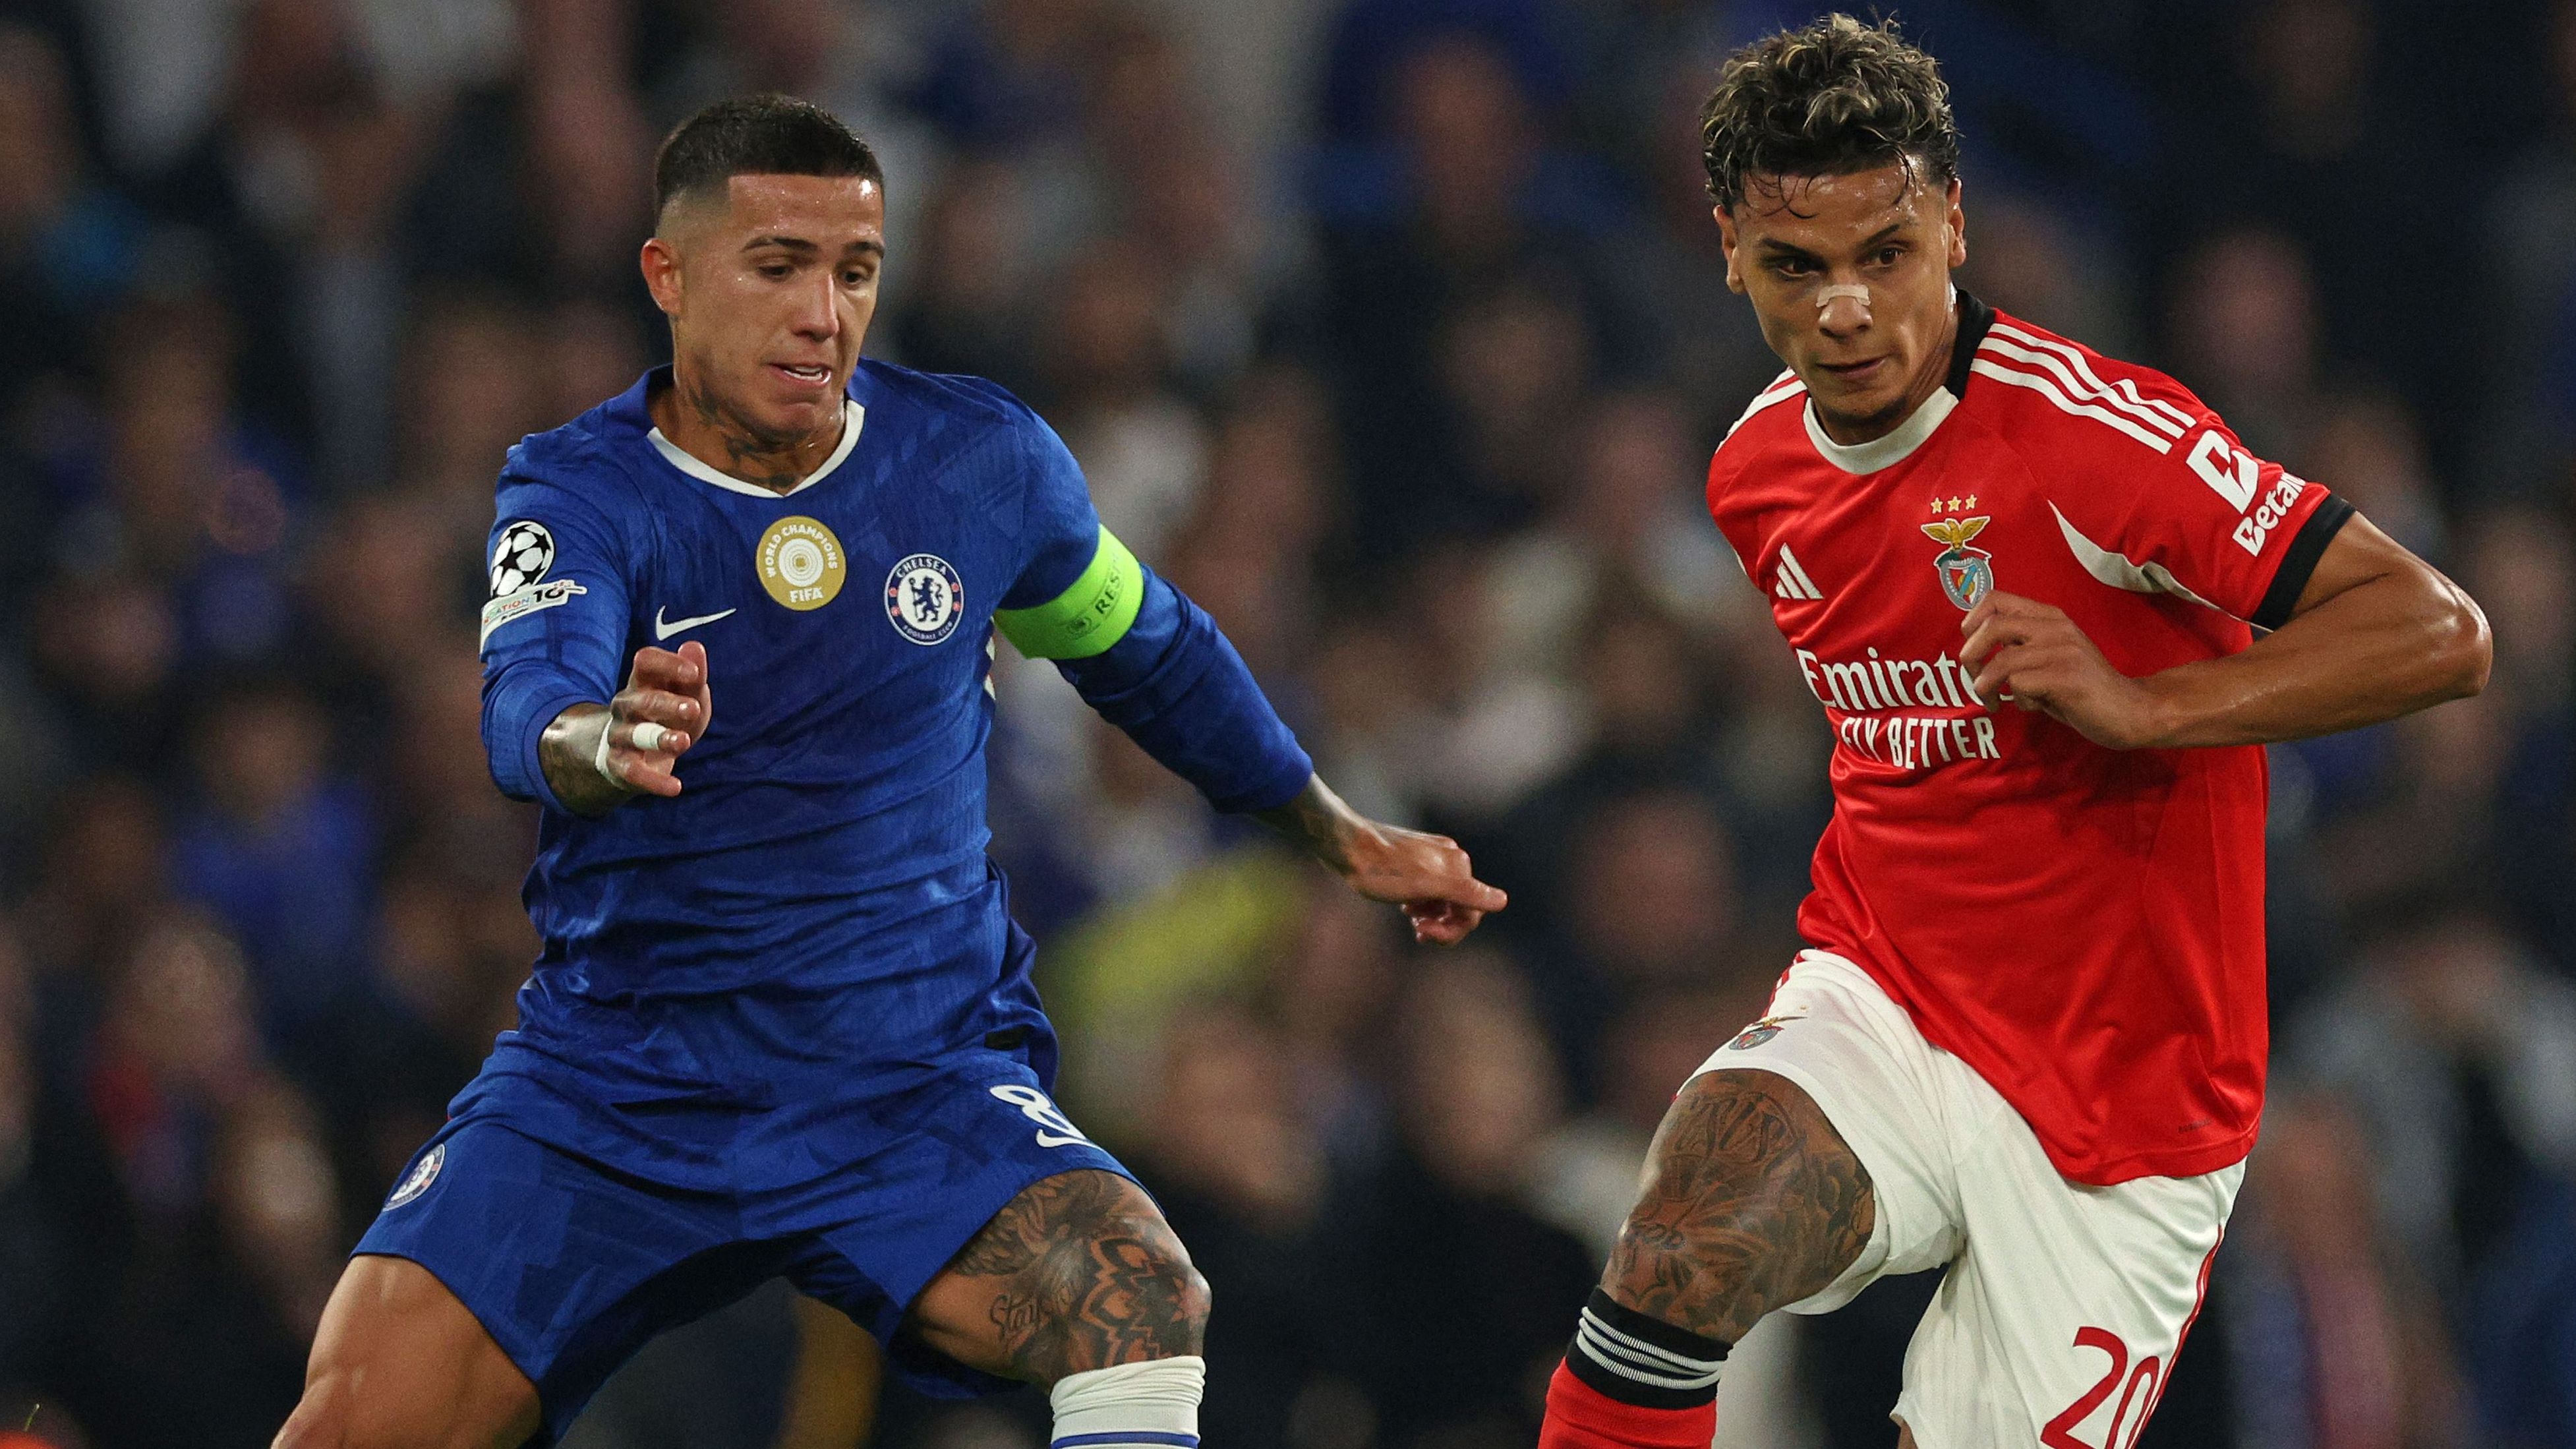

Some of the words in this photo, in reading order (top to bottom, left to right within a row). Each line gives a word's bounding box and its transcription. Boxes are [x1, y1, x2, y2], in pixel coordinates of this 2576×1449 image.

[765, 534, 782, 577] WORLD
[781, 524, 838, 569] CHAMPIONS
[896, 558, 947, 578] CHELSEA
[533, 588, 566, 603] 10
[790, 587, 823, 603] FIFA
[1095, 566, 1122, 614] RES
[1796, 647, 2014, 711] Emirat
[1887, 717, 2001, 770] BETTER
[989, 1085, 1087, 1140] 8
[2039, 1326, 2160, 1449] 20
